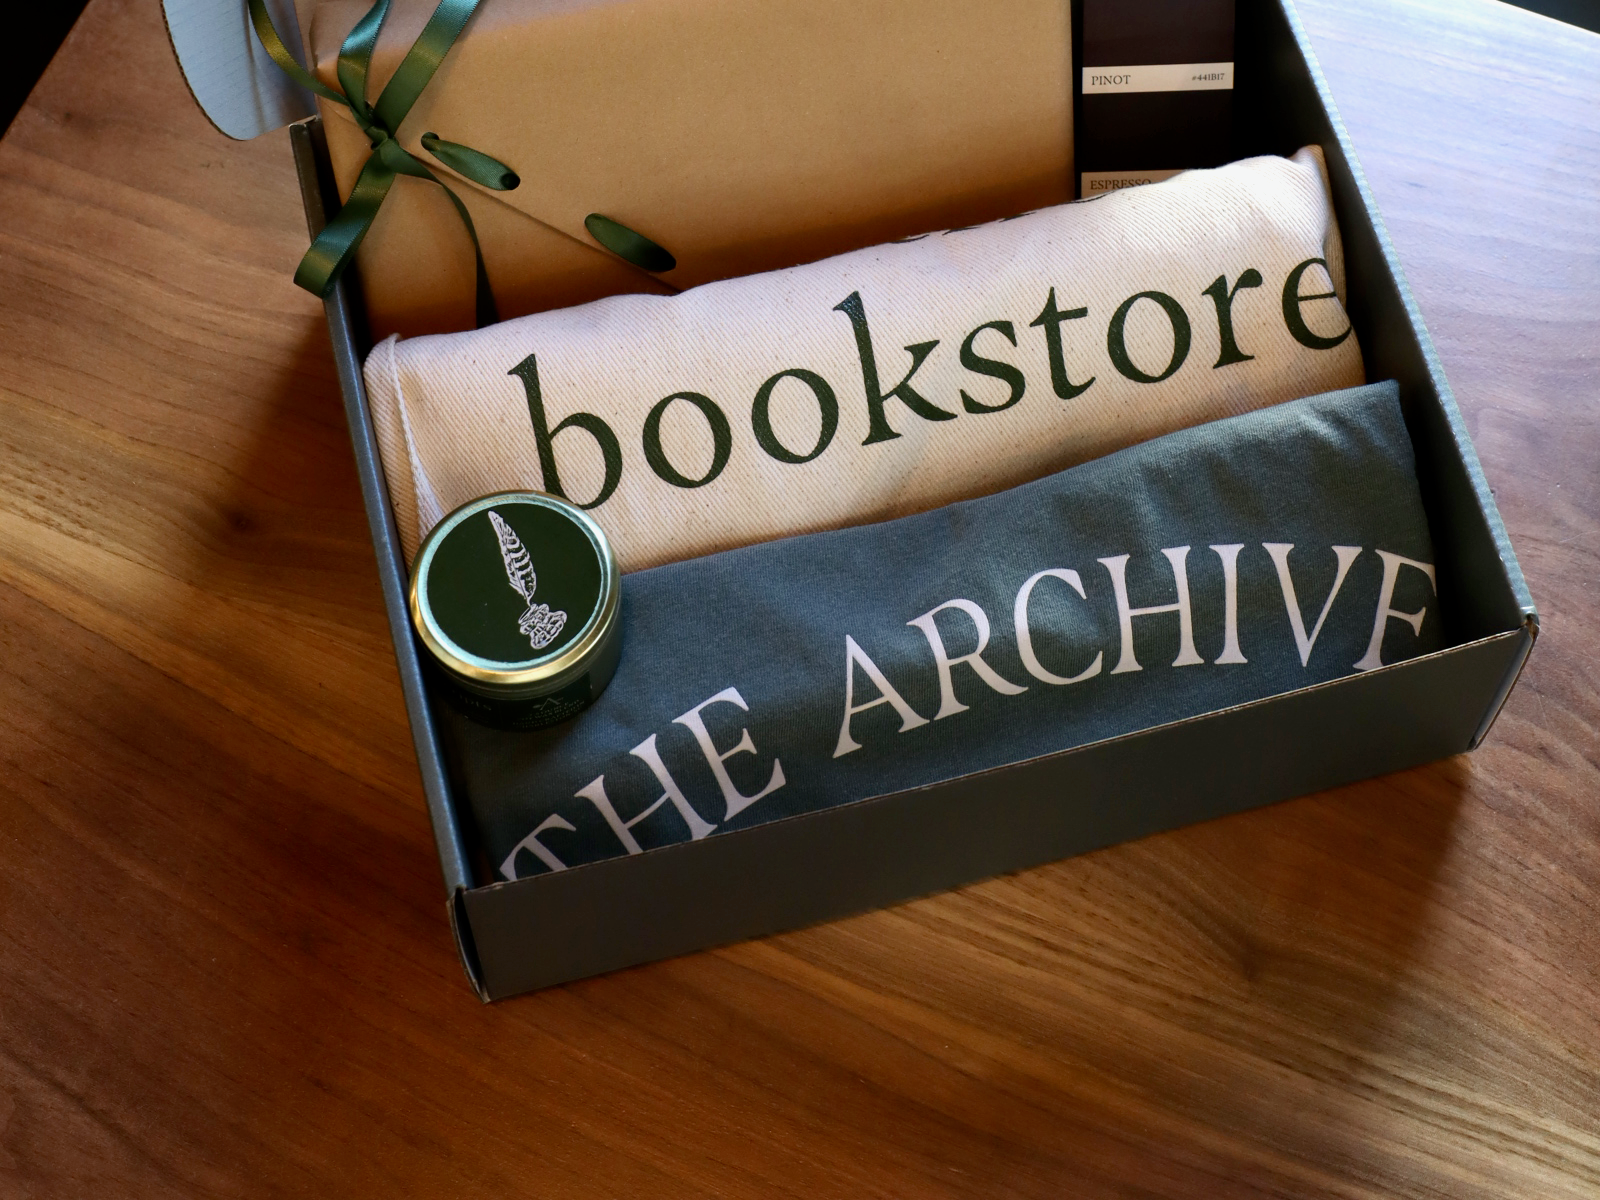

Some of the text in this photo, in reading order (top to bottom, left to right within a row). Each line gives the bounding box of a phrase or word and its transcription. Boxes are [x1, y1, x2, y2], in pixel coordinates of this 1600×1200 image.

[1091, 74, 1131, 86] PINOT
[507, 257, 1353, 510] bookstore
[832, 542, 1437, 758] ARCHIVE
